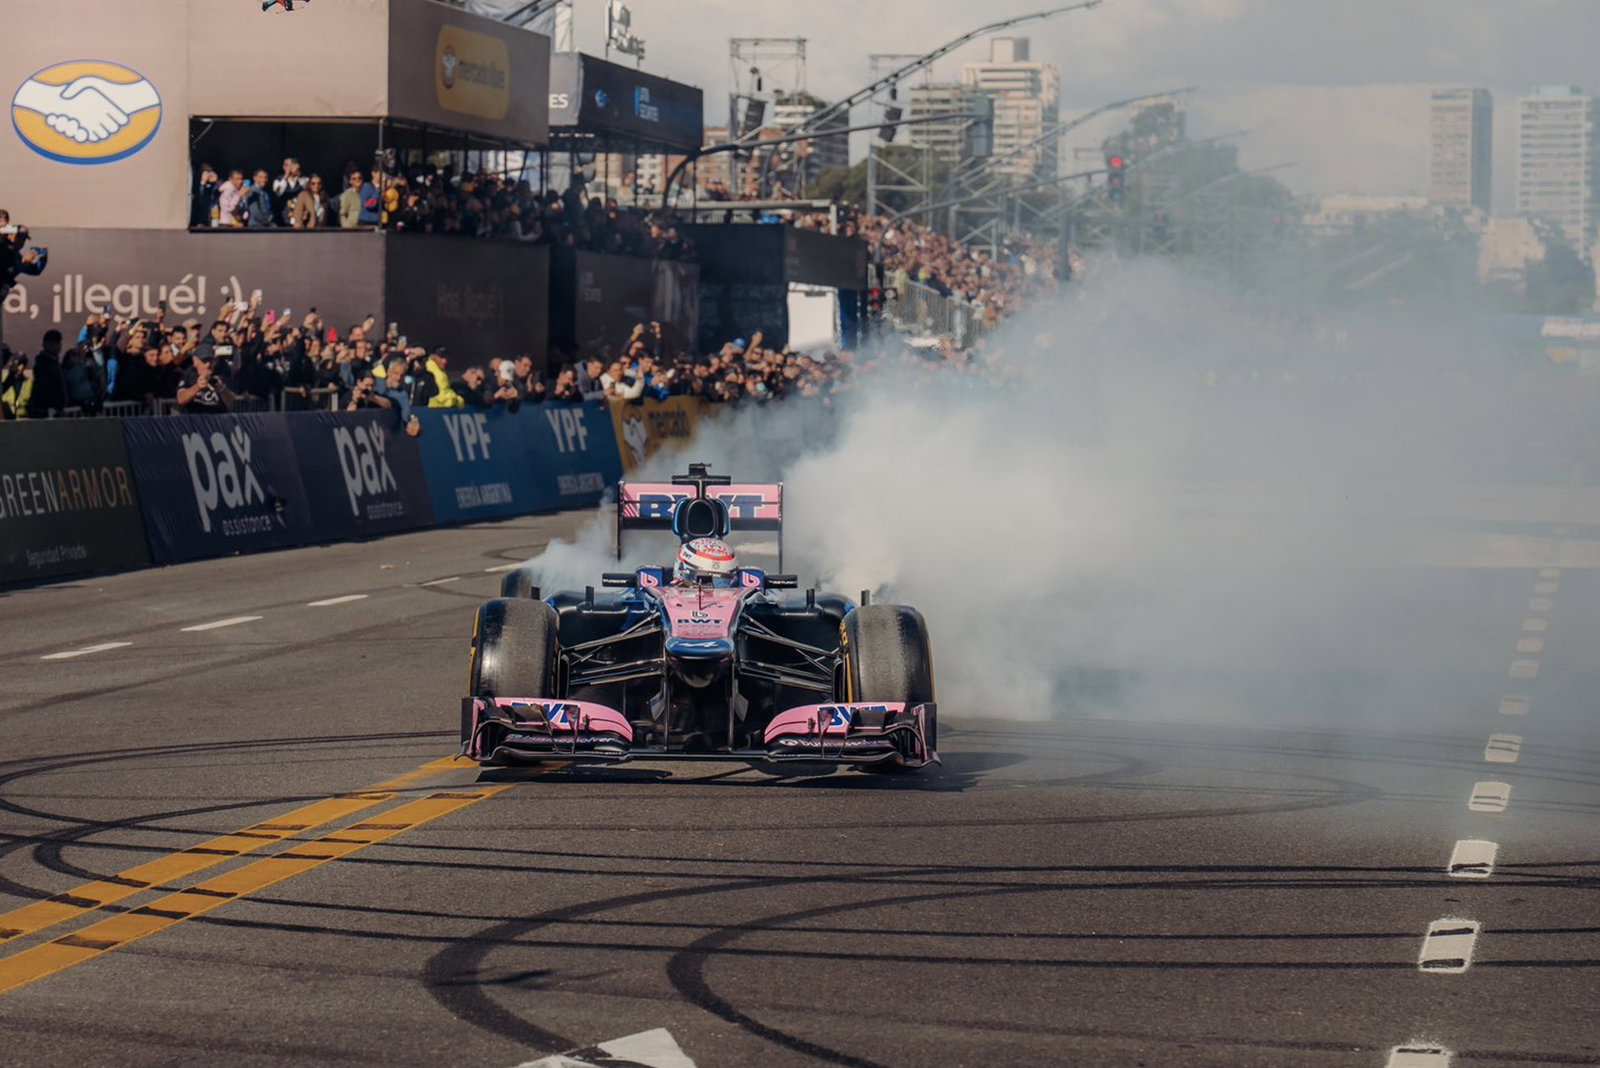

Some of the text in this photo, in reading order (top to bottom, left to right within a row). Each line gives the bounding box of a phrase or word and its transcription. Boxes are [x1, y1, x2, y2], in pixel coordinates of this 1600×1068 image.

[53, 273, 207, 322] ¡llegué!
[443, 413, 491, 462] YPF
[545, 408, 588, 452] YPF
[182, 425, 265, 532] pax
[333, 420, 397, 516] pax
